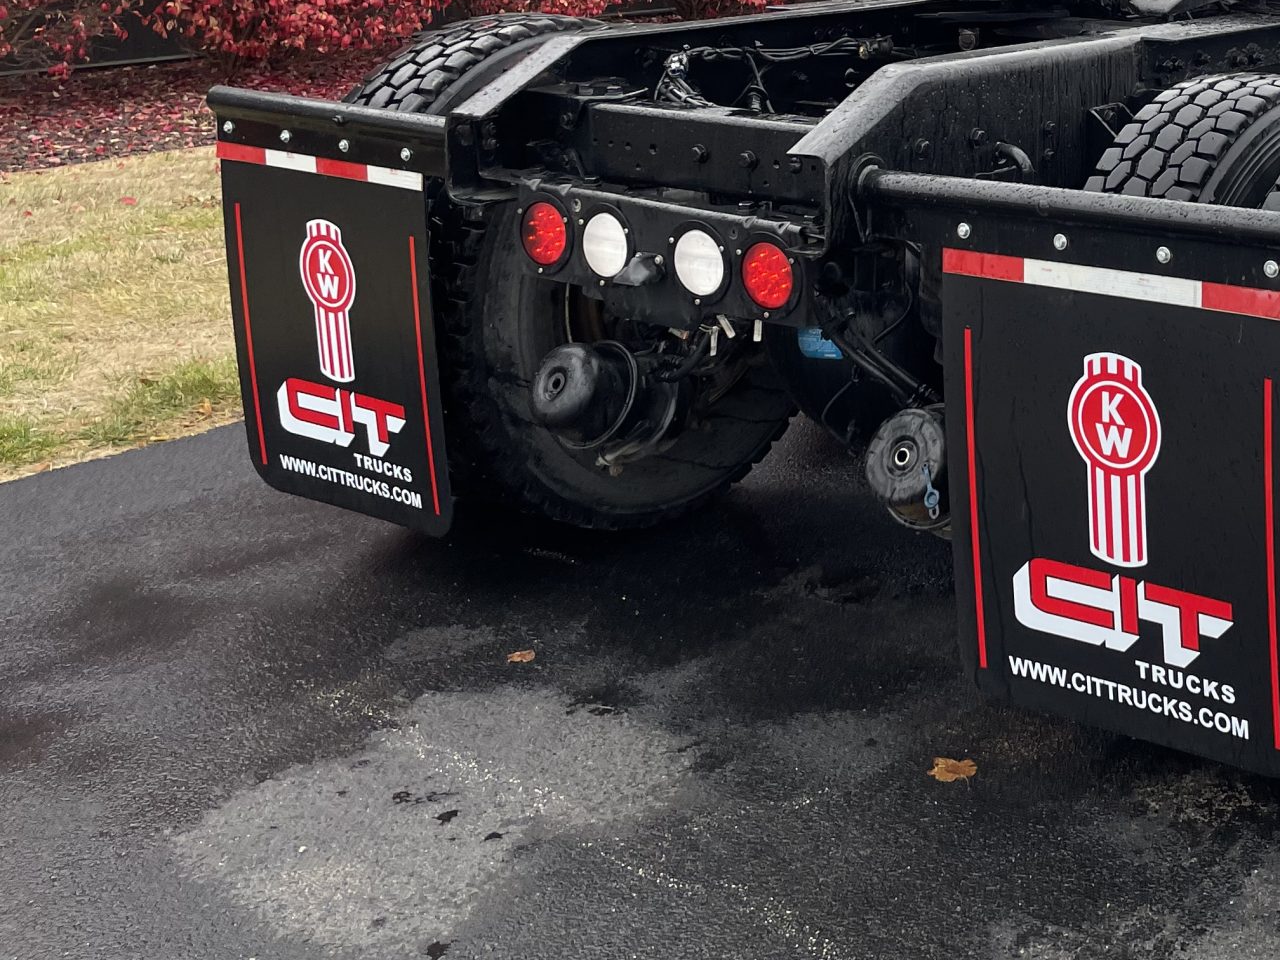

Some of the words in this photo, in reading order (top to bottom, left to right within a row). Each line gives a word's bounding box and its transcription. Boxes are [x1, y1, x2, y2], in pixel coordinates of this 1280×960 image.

[277, 377, 406, 457] CIT
[279, 453, 423, 509] WWW.CITTRUCKS.COM
[353, 452, 413, 483] TRUCKS
[1012, 557, 1234, 669] CIT
[1008, 655, 1250, 741] WWW.CITTRUCKS.COM
[1135, 659, 1236, 705] TRUCKS
